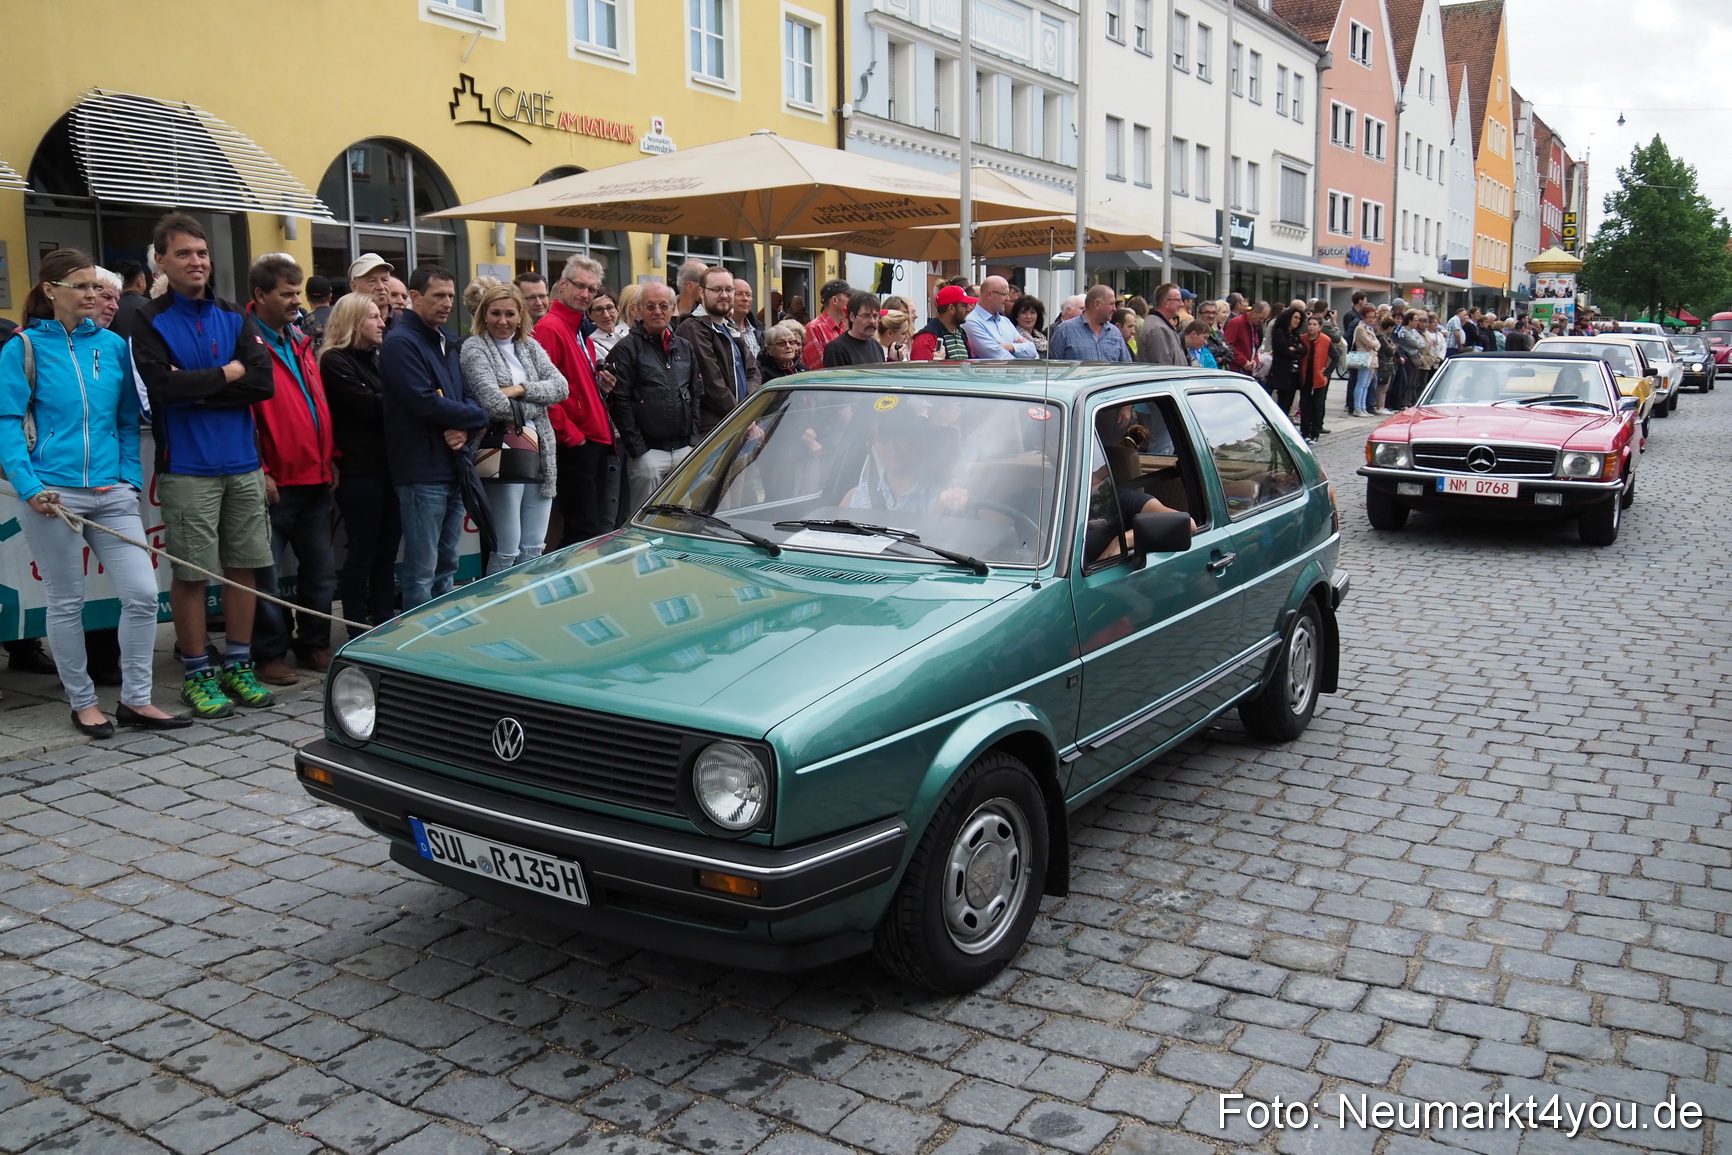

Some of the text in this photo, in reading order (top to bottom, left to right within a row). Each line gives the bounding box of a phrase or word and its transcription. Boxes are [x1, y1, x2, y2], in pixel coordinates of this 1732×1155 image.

[495, 87, 636, 145] CAFÉ AM RATHAUS
[827, 264, 836, 275] 24
[1448, 478, 1510, 495] NM 0768
[426, 828, 477, 869] SUL
